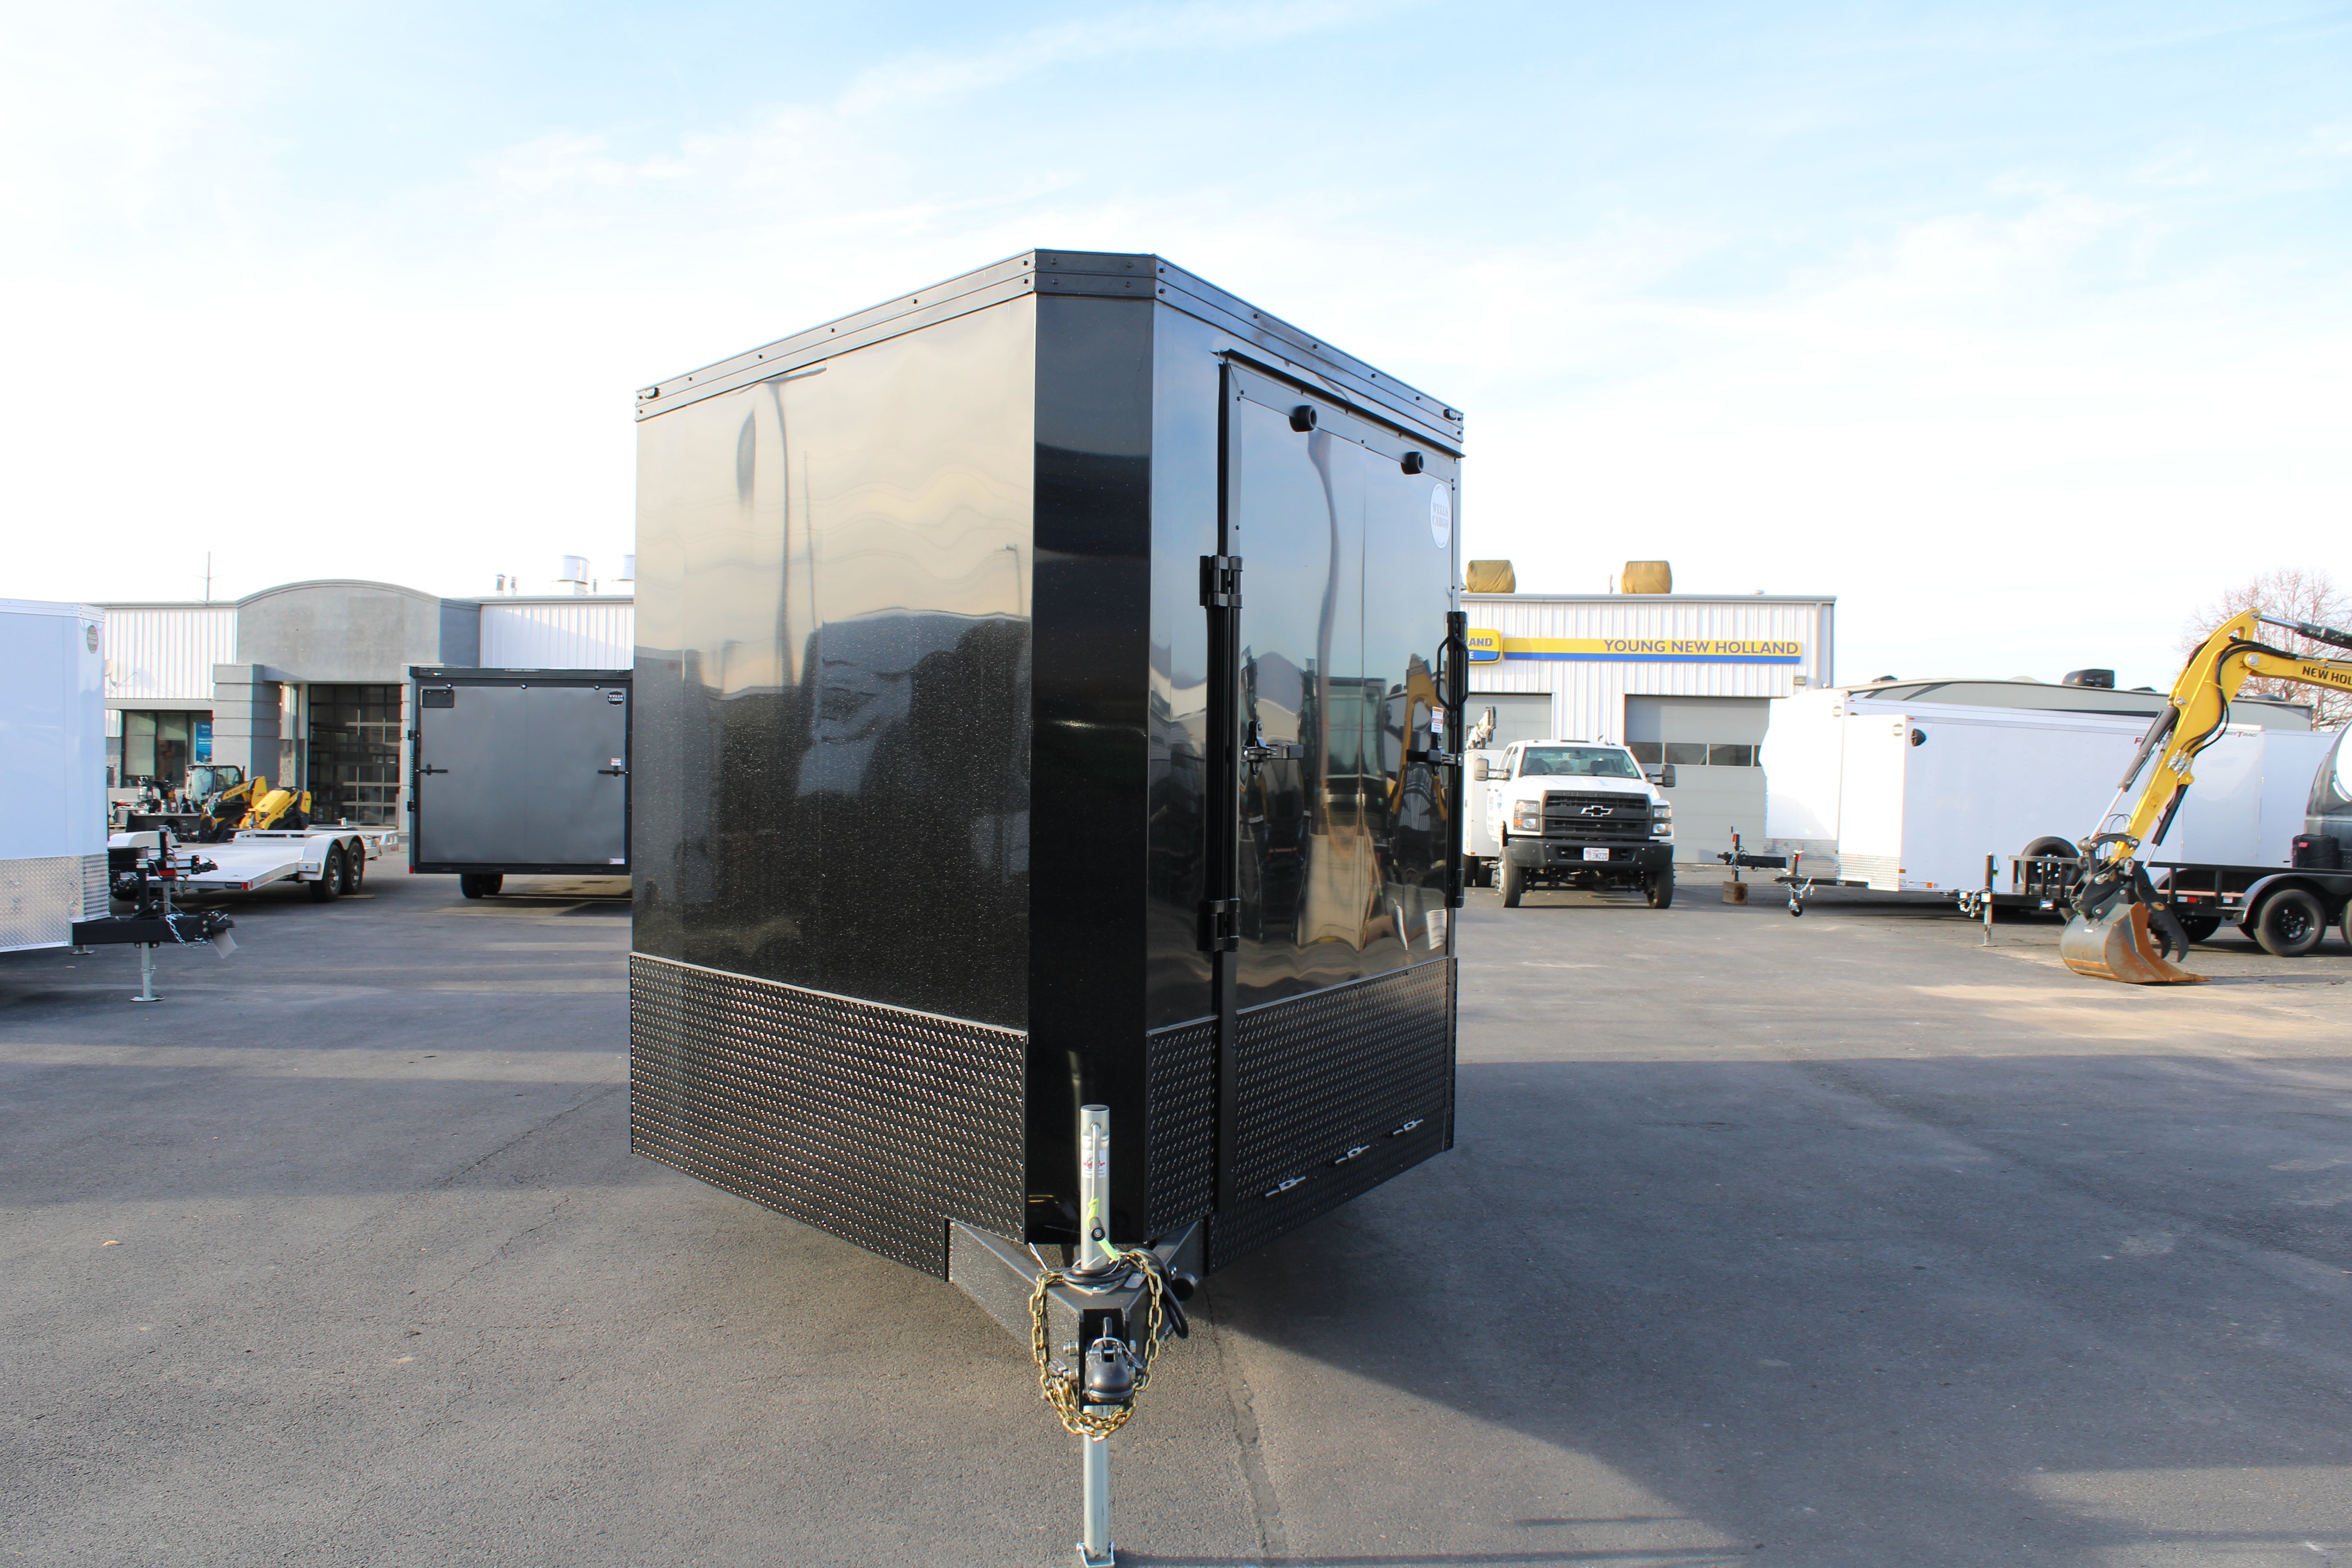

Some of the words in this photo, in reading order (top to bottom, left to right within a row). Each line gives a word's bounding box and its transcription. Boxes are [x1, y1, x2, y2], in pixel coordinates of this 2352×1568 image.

[1604, 639, 1666, 653] YOUNG
[1671, 641, 1710, 653] NEW
[1715, 641, 1799, 654] HOLLAND
[2302, 666, 2329, 680] NEW
